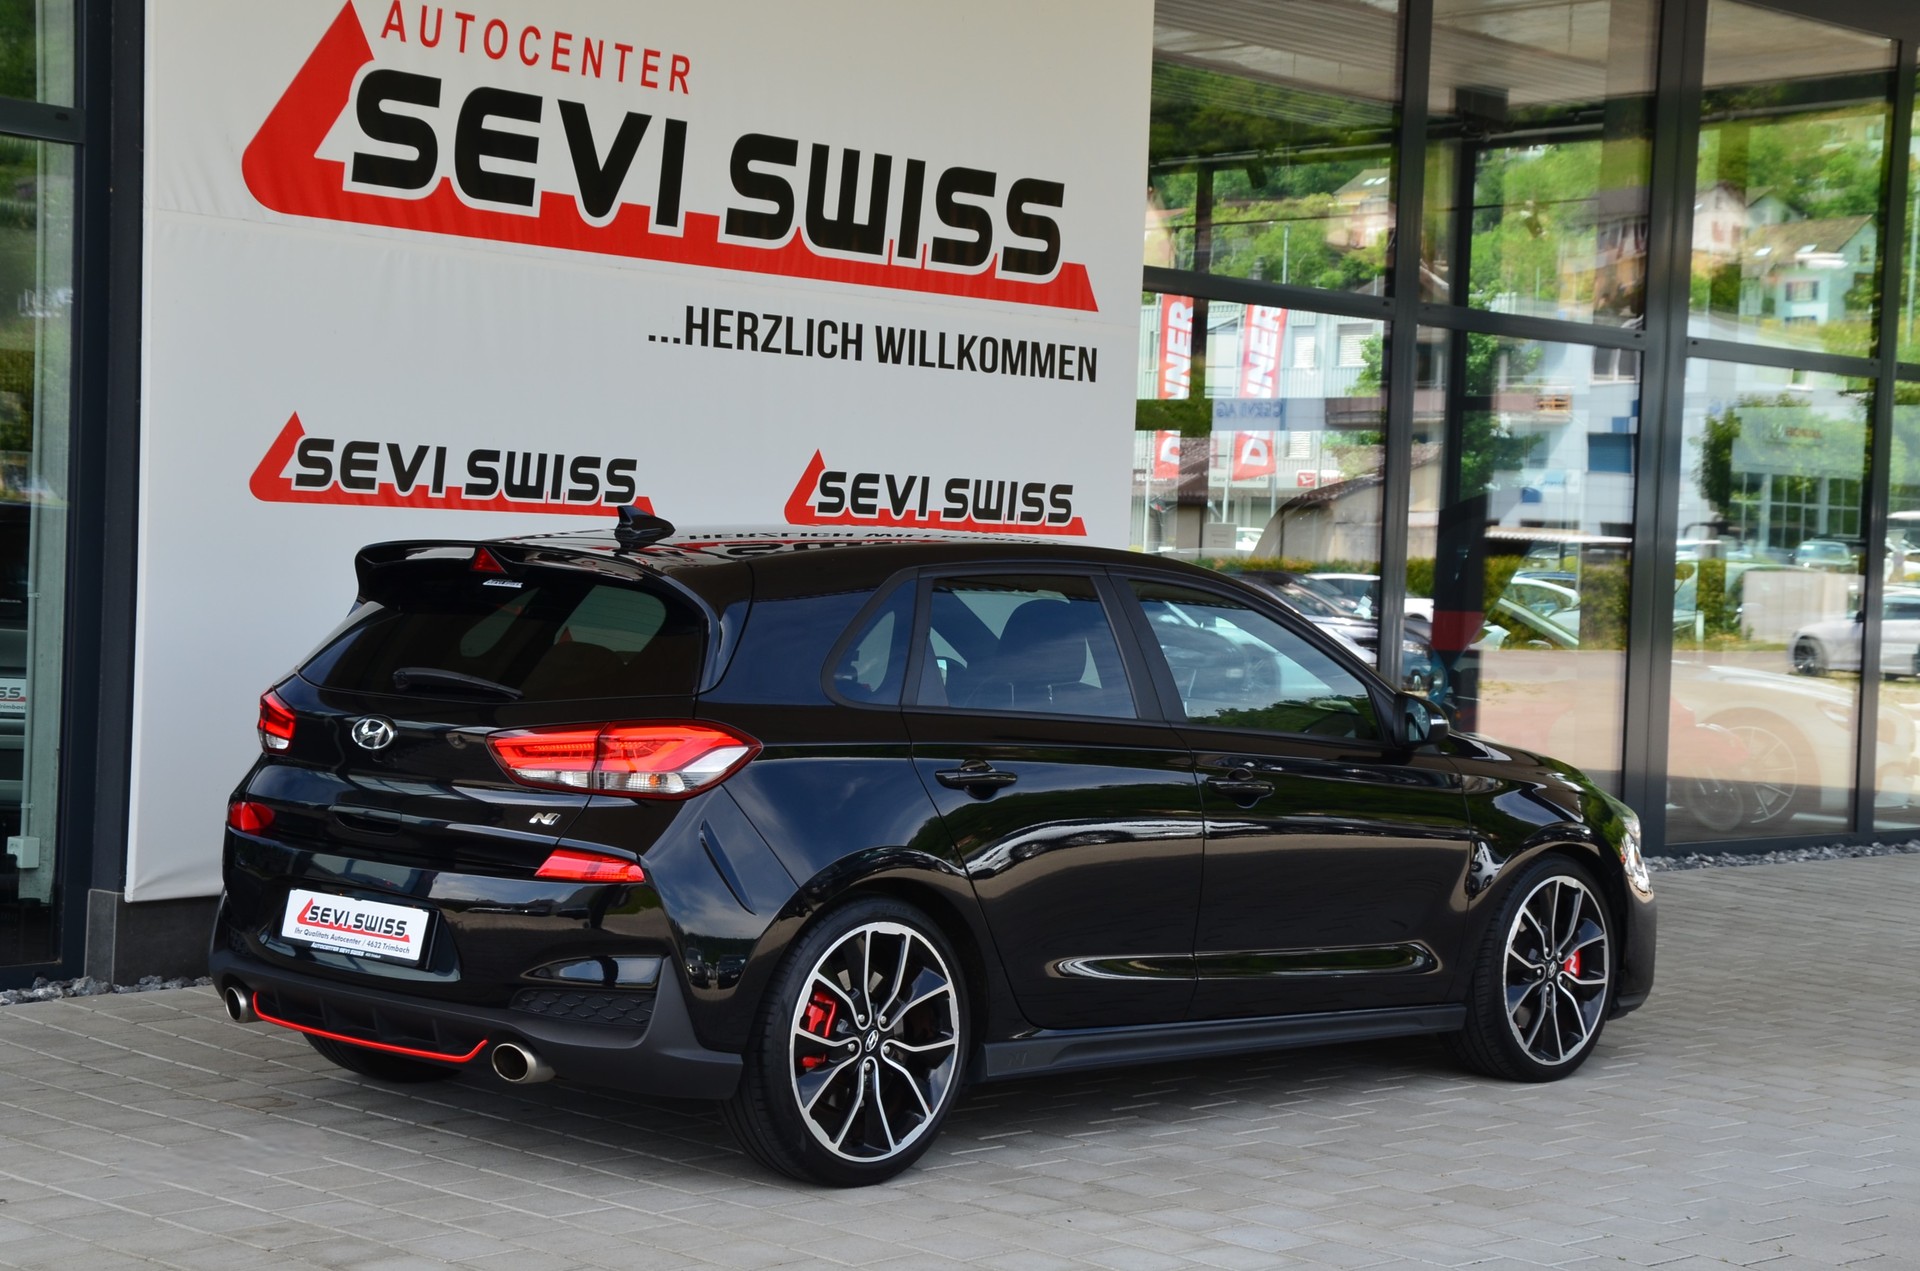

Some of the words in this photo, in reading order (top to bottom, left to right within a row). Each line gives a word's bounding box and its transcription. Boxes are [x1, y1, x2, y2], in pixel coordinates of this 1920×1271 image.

[381, 0, 691, 95] AUTOCENTER
[351, 69, 688, 228] SEVI
[724, 133, 1065, 276] SWISS
[875, 325, 1097, 383] WILLKOMMEN
[295, 437, 447, 494] SEVI
[464, 449, 638, 504] SWISS
[817, 471, 930, 517] SEVI
[942, 478, 1074, 524] SWISS
[529, 812, 561, 825] N
[308, 905, 350, 927] SEVI
[352, 913, 407, 937] SWISS
[330, 934, 361, 945] Autocenter
[367, 940, 381, 949] 4632
[382, 942, 411, 954] Trimbach
